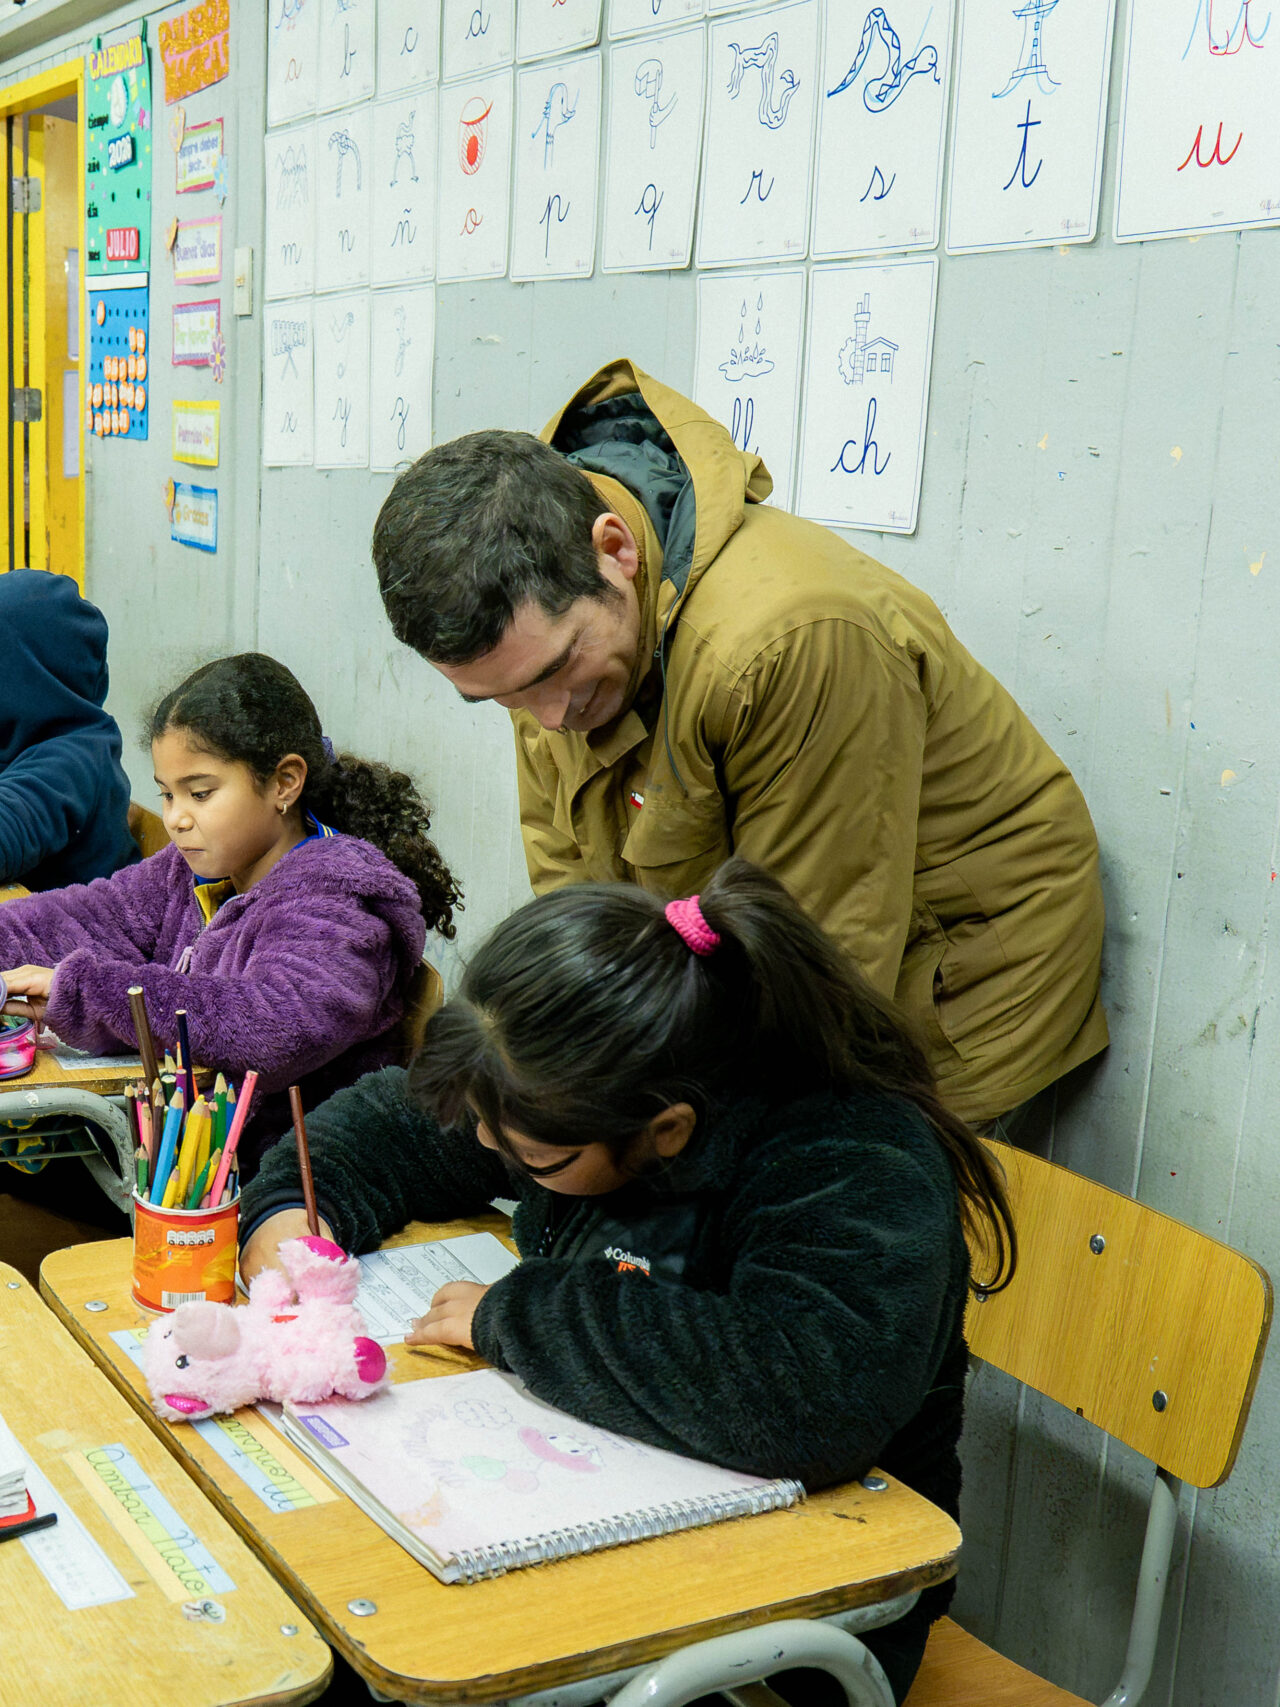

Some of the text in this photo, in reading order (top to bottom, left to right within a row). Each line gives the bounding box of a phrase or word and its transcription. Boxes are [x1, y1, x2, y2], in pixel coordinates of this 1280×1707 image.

[89, 35, 145, 81] CALENDARIO
[340, 23, 356, 78] b
[400, 27, 418, 55] c
[285, 58, 302, 82] a
[1003, 99, 1042, 190] t
[1177, 122, 1242, 171] u
[740, 169, 774, 204] r
[860, 166, 896, 202] s
[391, 208, 416, 247] ñ
[460, 208, 483, 235] o
[539, 195, 570, 258] p
[635, 184, 664, 250] q
[108, 229, 136, 258] JULIO
[282, 242, 301, 265] m
[338, 229, 354, 252] n
[333, 398, 351, 447] y
[390, 397, 409, 451] z
[830, 398, 891, 475] ch
[612, 1247, 651, 1272] Columbi
[87, 1448, 151, 1526] Ambar
